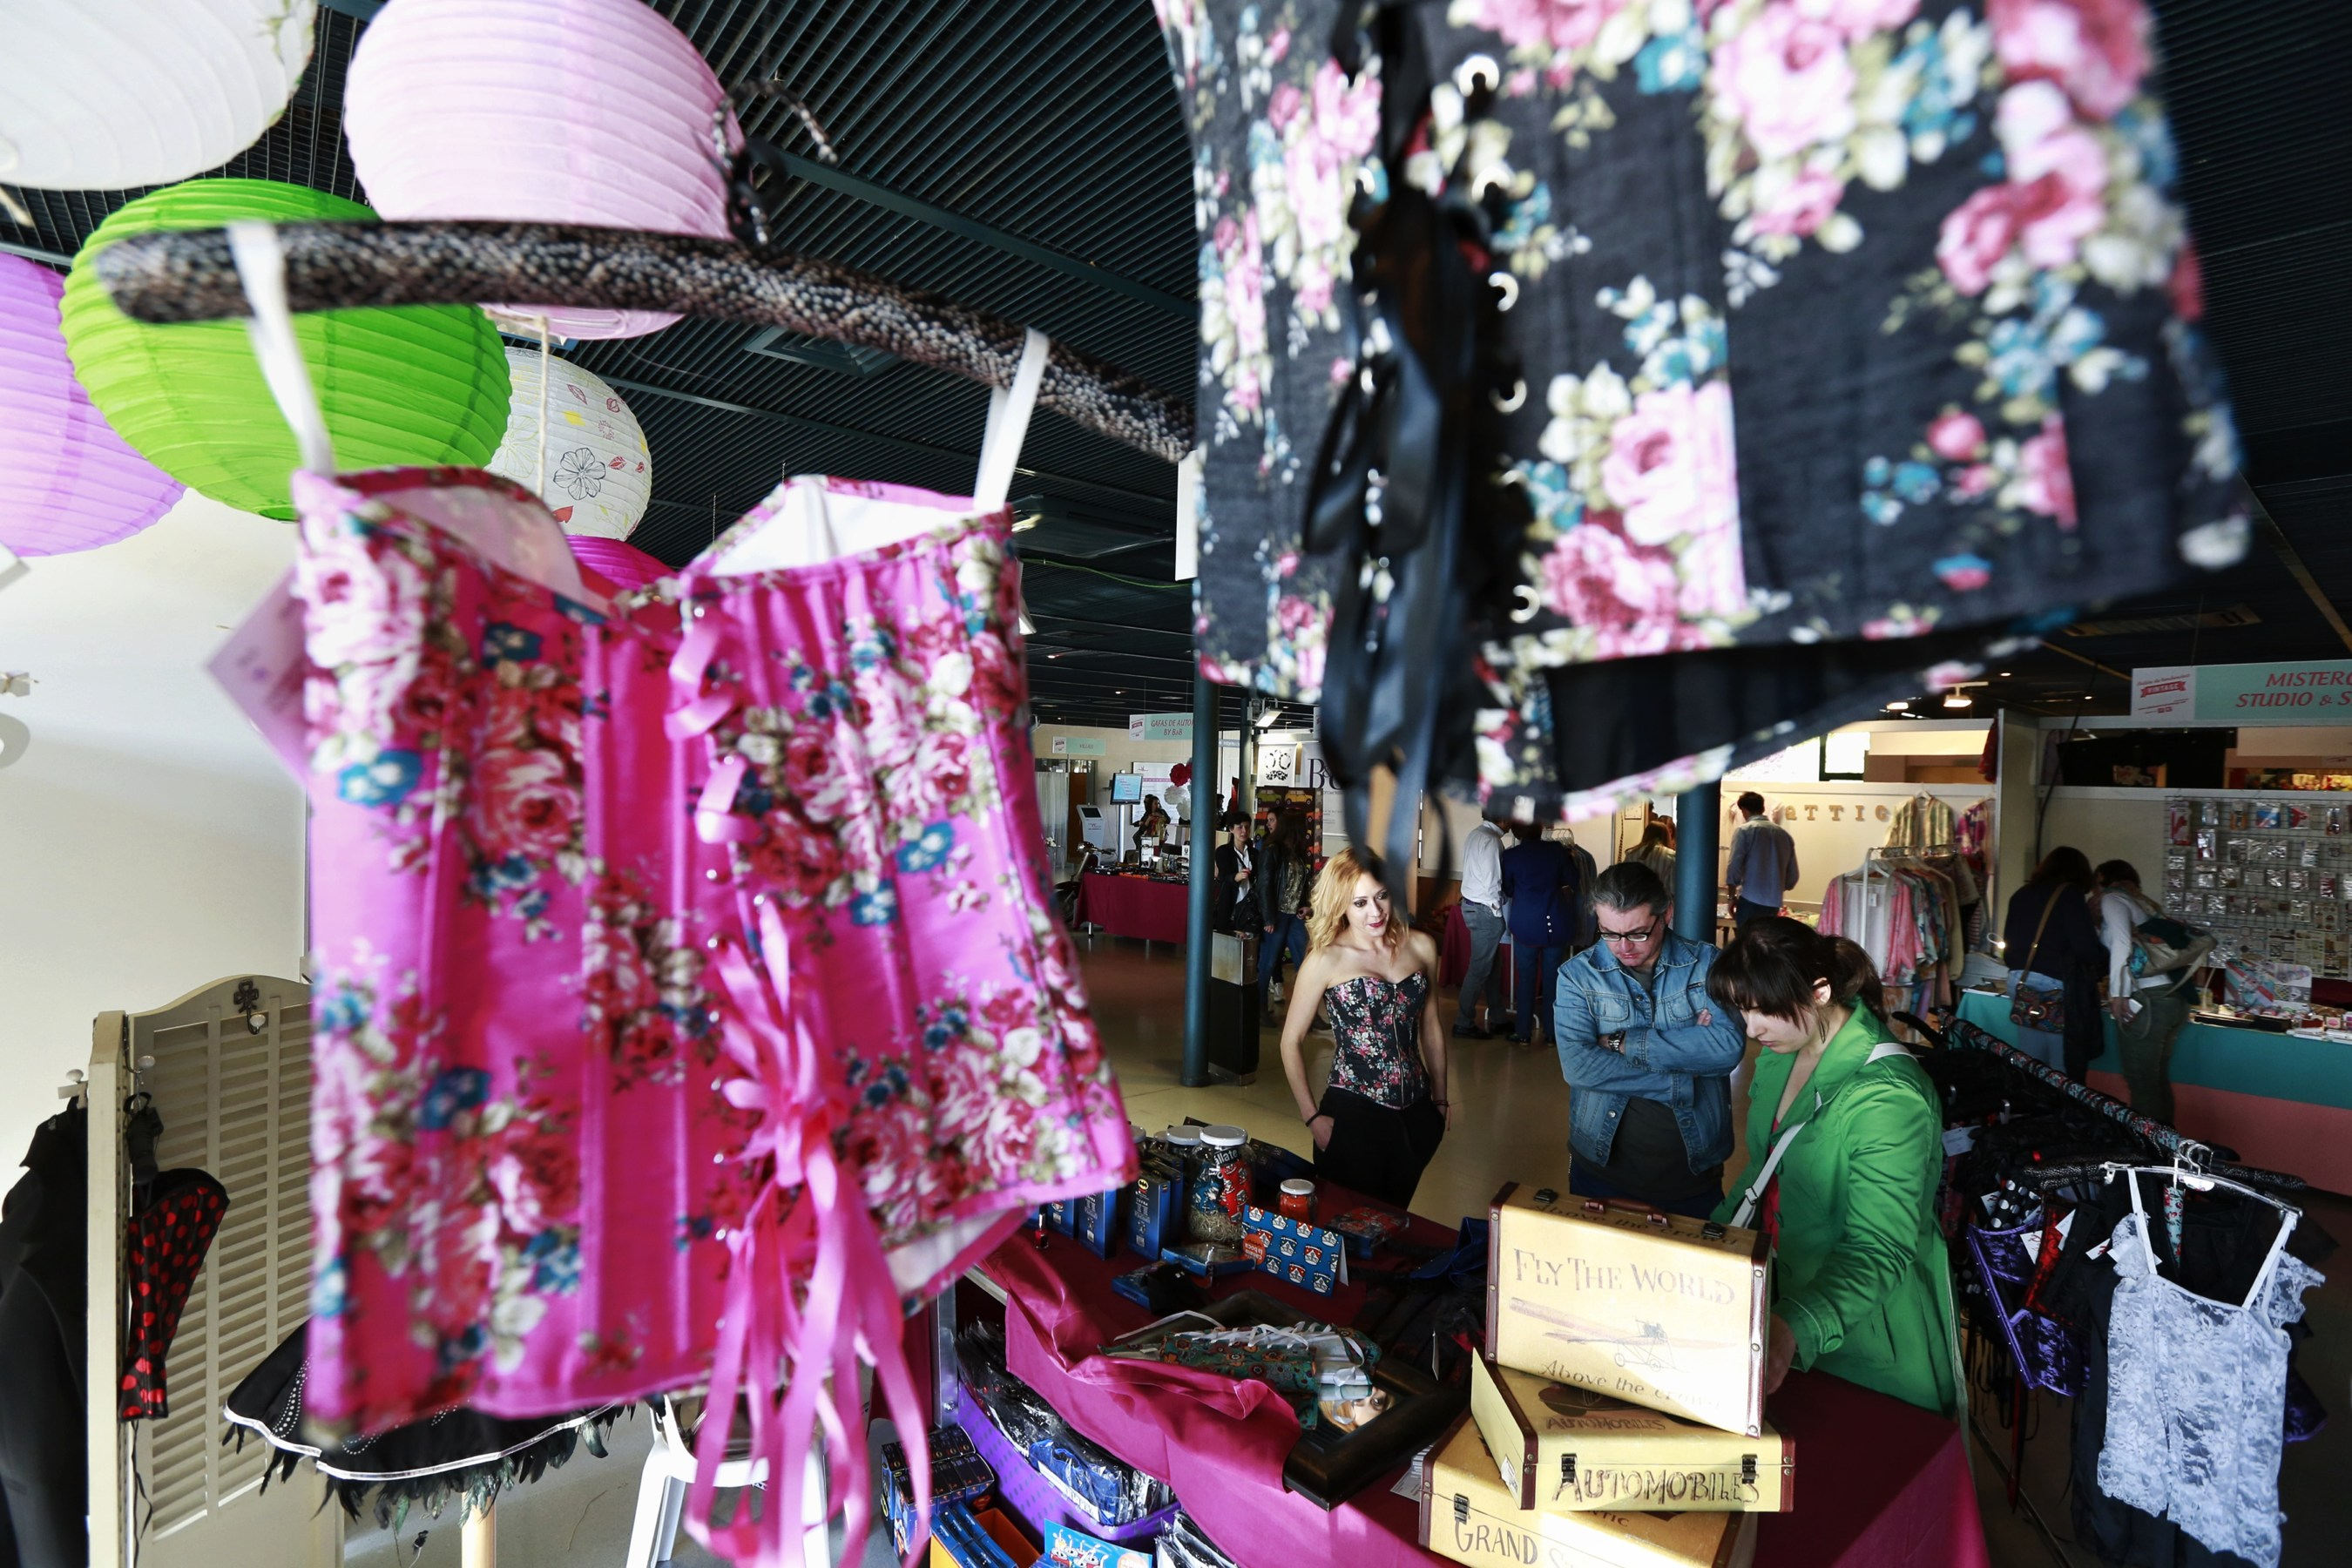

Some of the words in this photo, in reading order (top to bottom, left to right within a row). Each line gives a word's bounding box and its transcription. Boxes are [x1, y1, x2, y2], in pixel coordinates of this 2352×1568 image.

[2236, 692, 2314, 707] STUDIO
[2319, 695, 2333, 706] &
[2337, 691, 2352, 706] S
[1615, 1219, 1650, 1230] the
[1514, 1247, 1564, 1288] FLY
[1568, 1256, 1622, 1291] THE
[1630, 1263, 1735, 1306] WORLD
[1538, 1360, 1607, 1387] Above
[1616, 1377, 1645, 1395] the
[1546, 1416, 1666, 1431] AUTOMOBILES
[1552, 1467, 1760, 1505] AUTOMOBILES
[1454, 1518, 1539, 1565] GRAND
